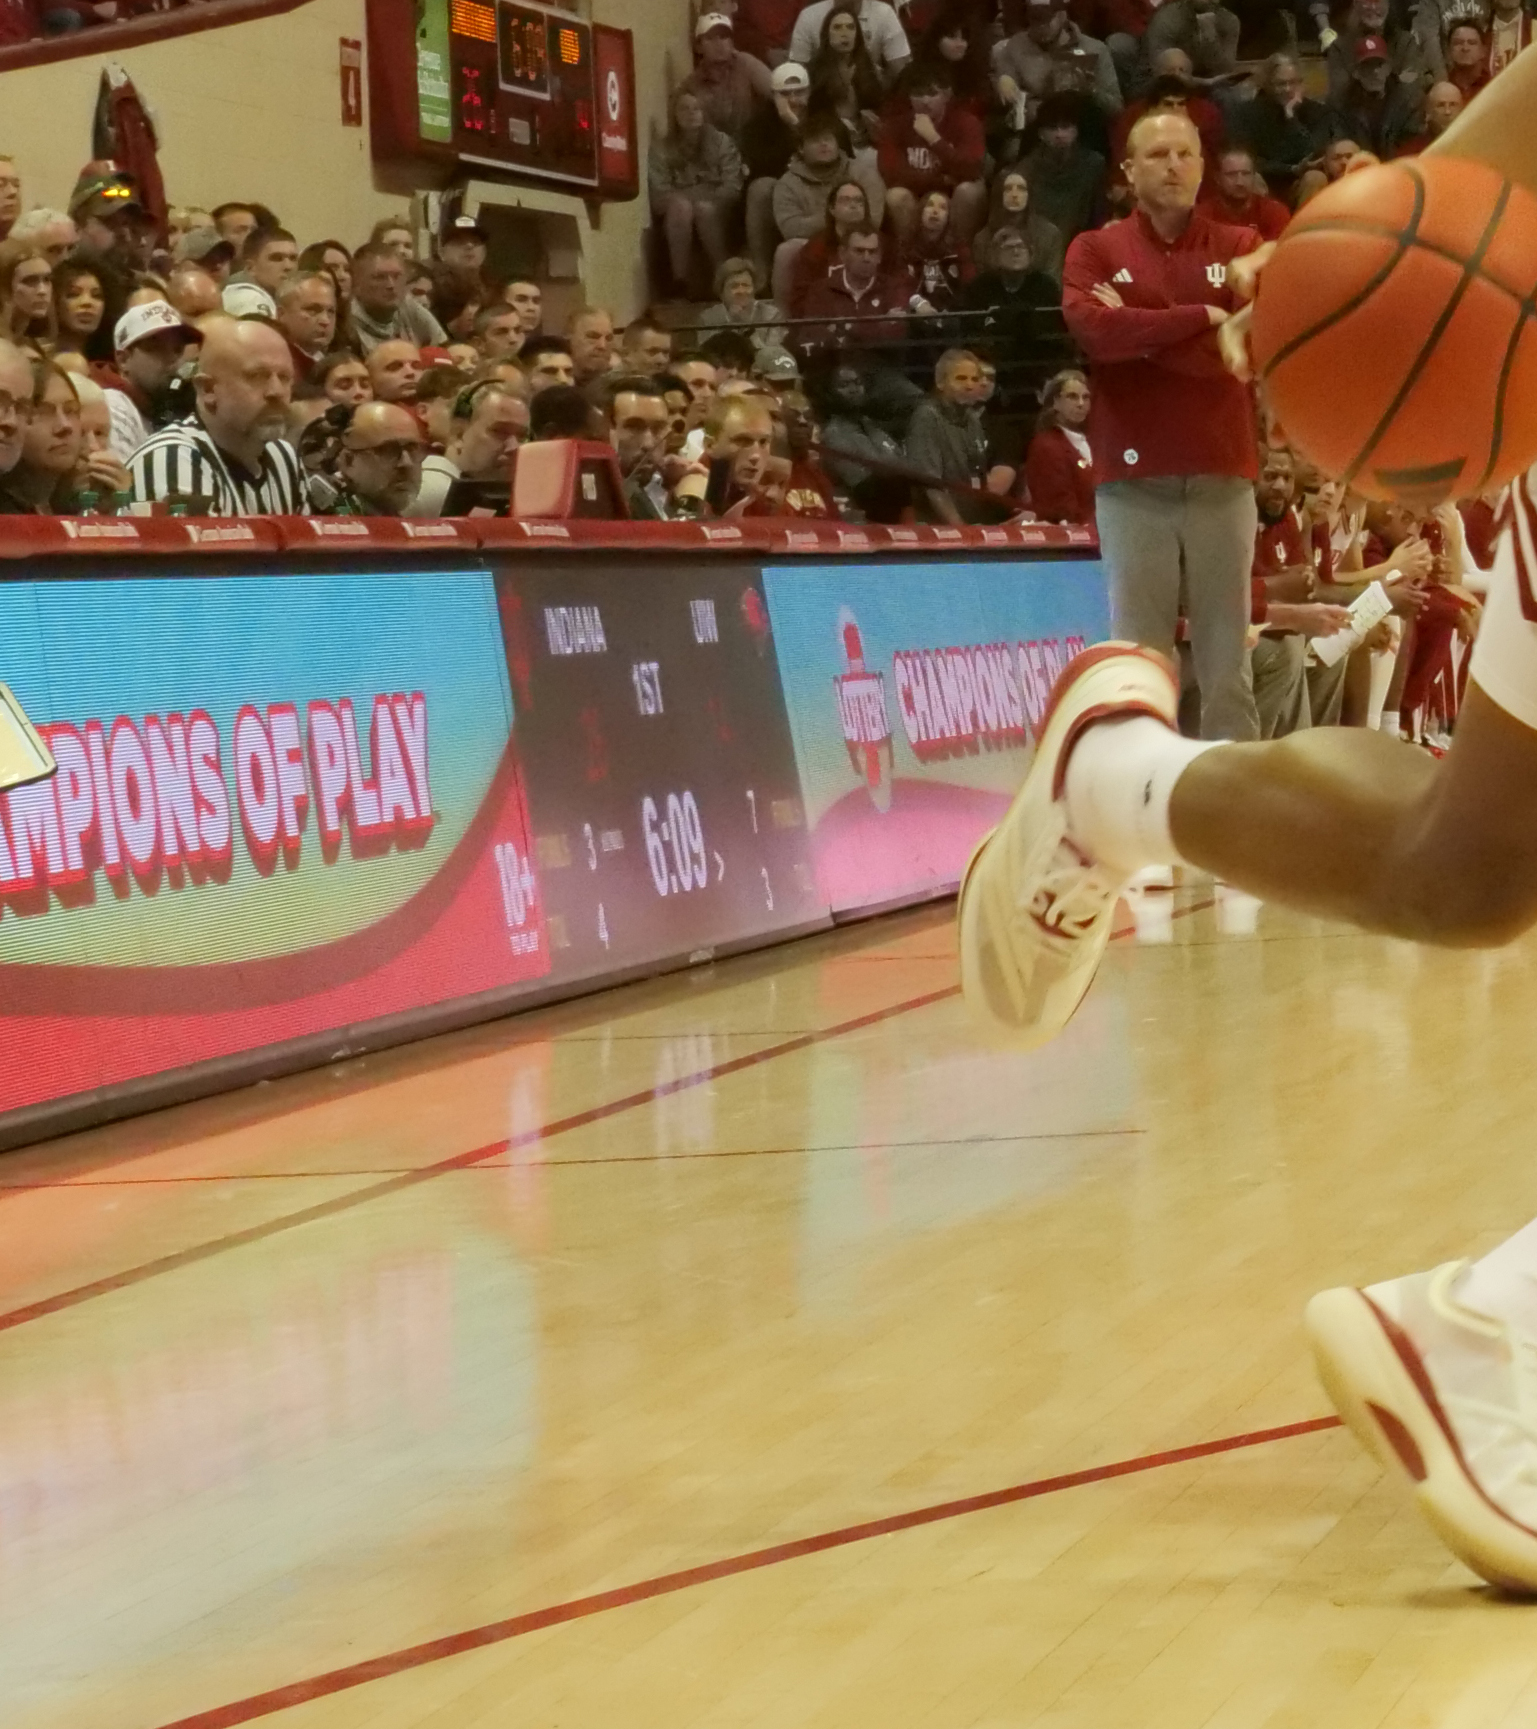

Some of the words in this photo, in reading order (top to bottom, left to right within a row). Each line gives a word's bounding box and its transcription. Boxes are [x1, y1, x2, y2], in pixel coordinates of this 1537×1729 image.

[632, 660, 665, 716] 1ST
[893, 644, 1026, 746] CHAMPIONS
[0, 708, 232, 886] MPIONS
[233, 703, 308, 855] OF
[307, 691, 435, 840] PLAY
[642, 790, 708, 897] 6:09
